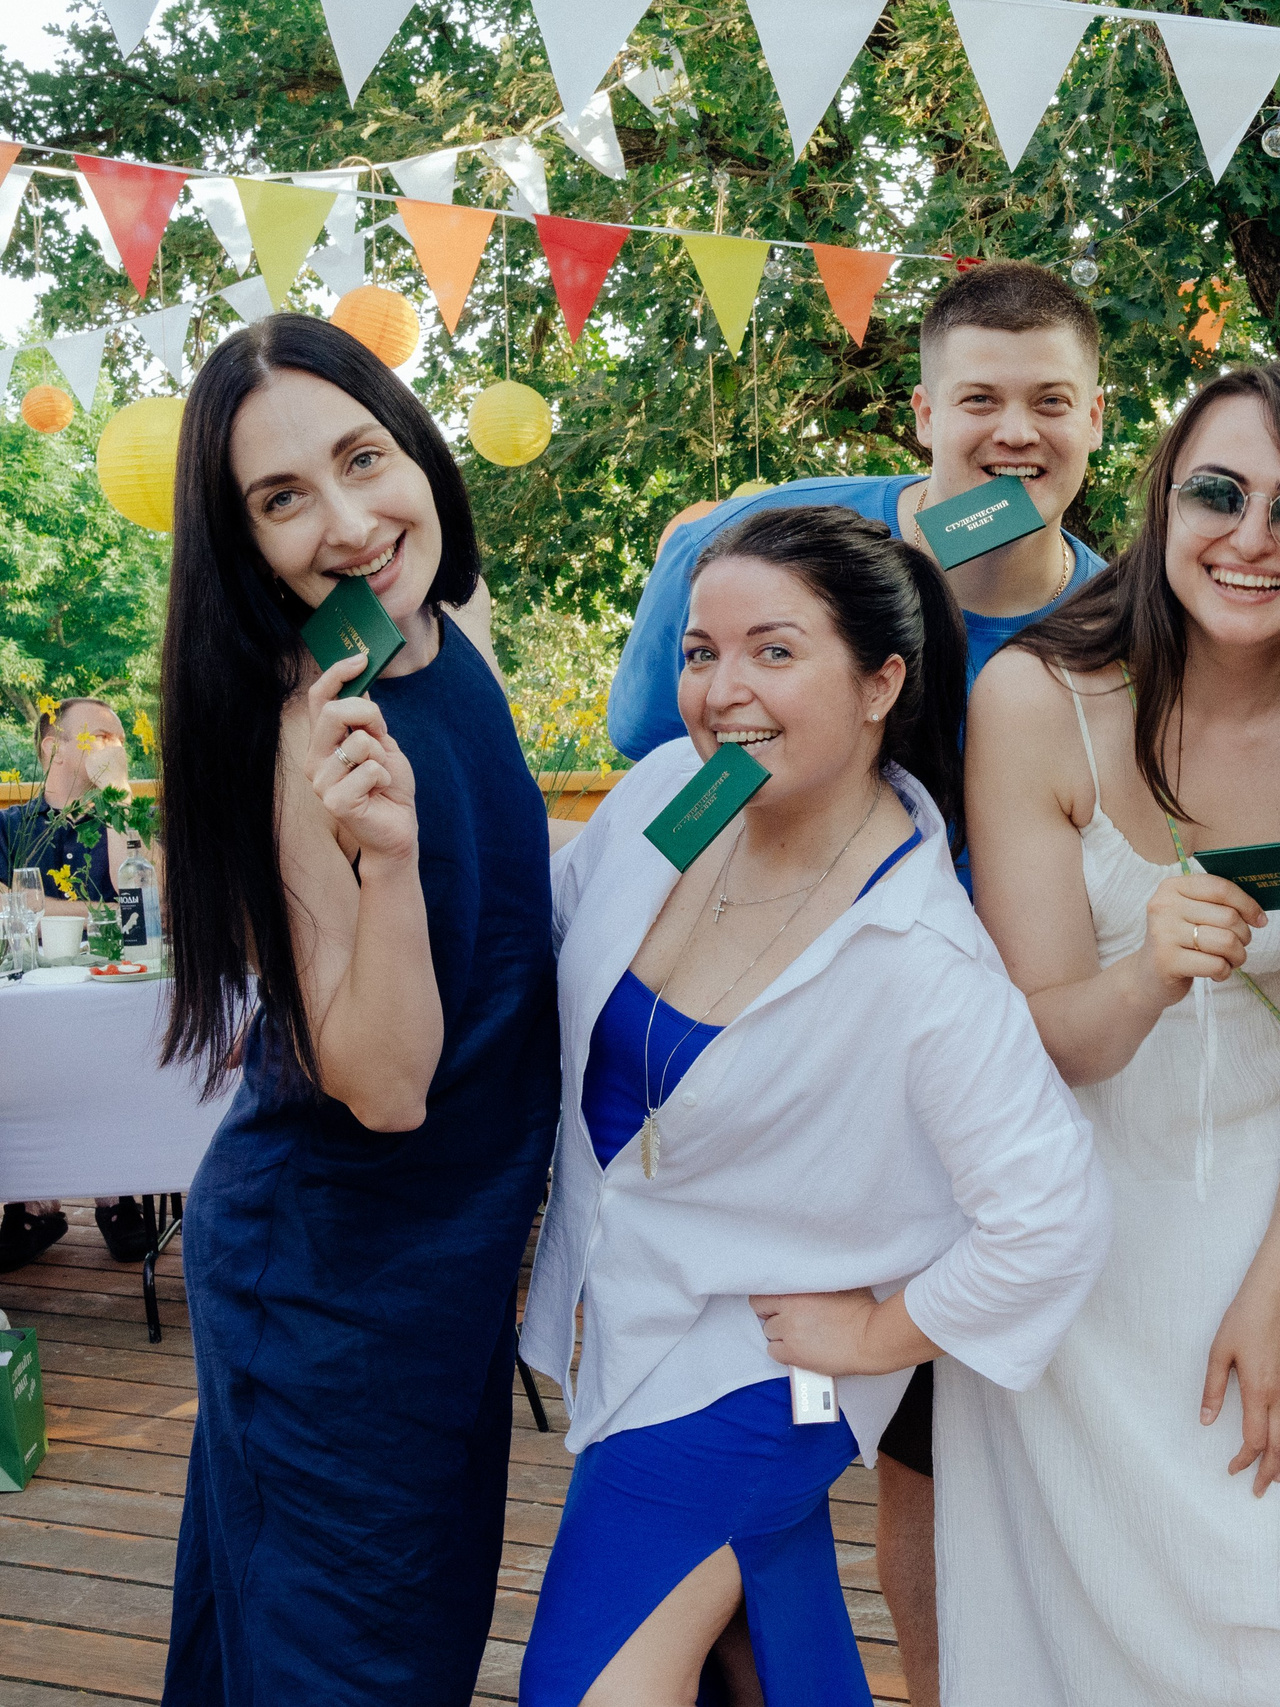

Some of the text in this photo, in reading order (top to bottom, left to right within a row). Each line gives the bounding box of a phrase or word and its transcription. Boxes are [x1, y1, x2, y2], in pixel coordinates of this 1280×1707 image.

[945, 499, 1010, 533] СТУДЕНЧЕСКИЙ
[967, 514, 994, 531] БИЛЕТ
[693, 793, 717, 820] БИЛЕТ
